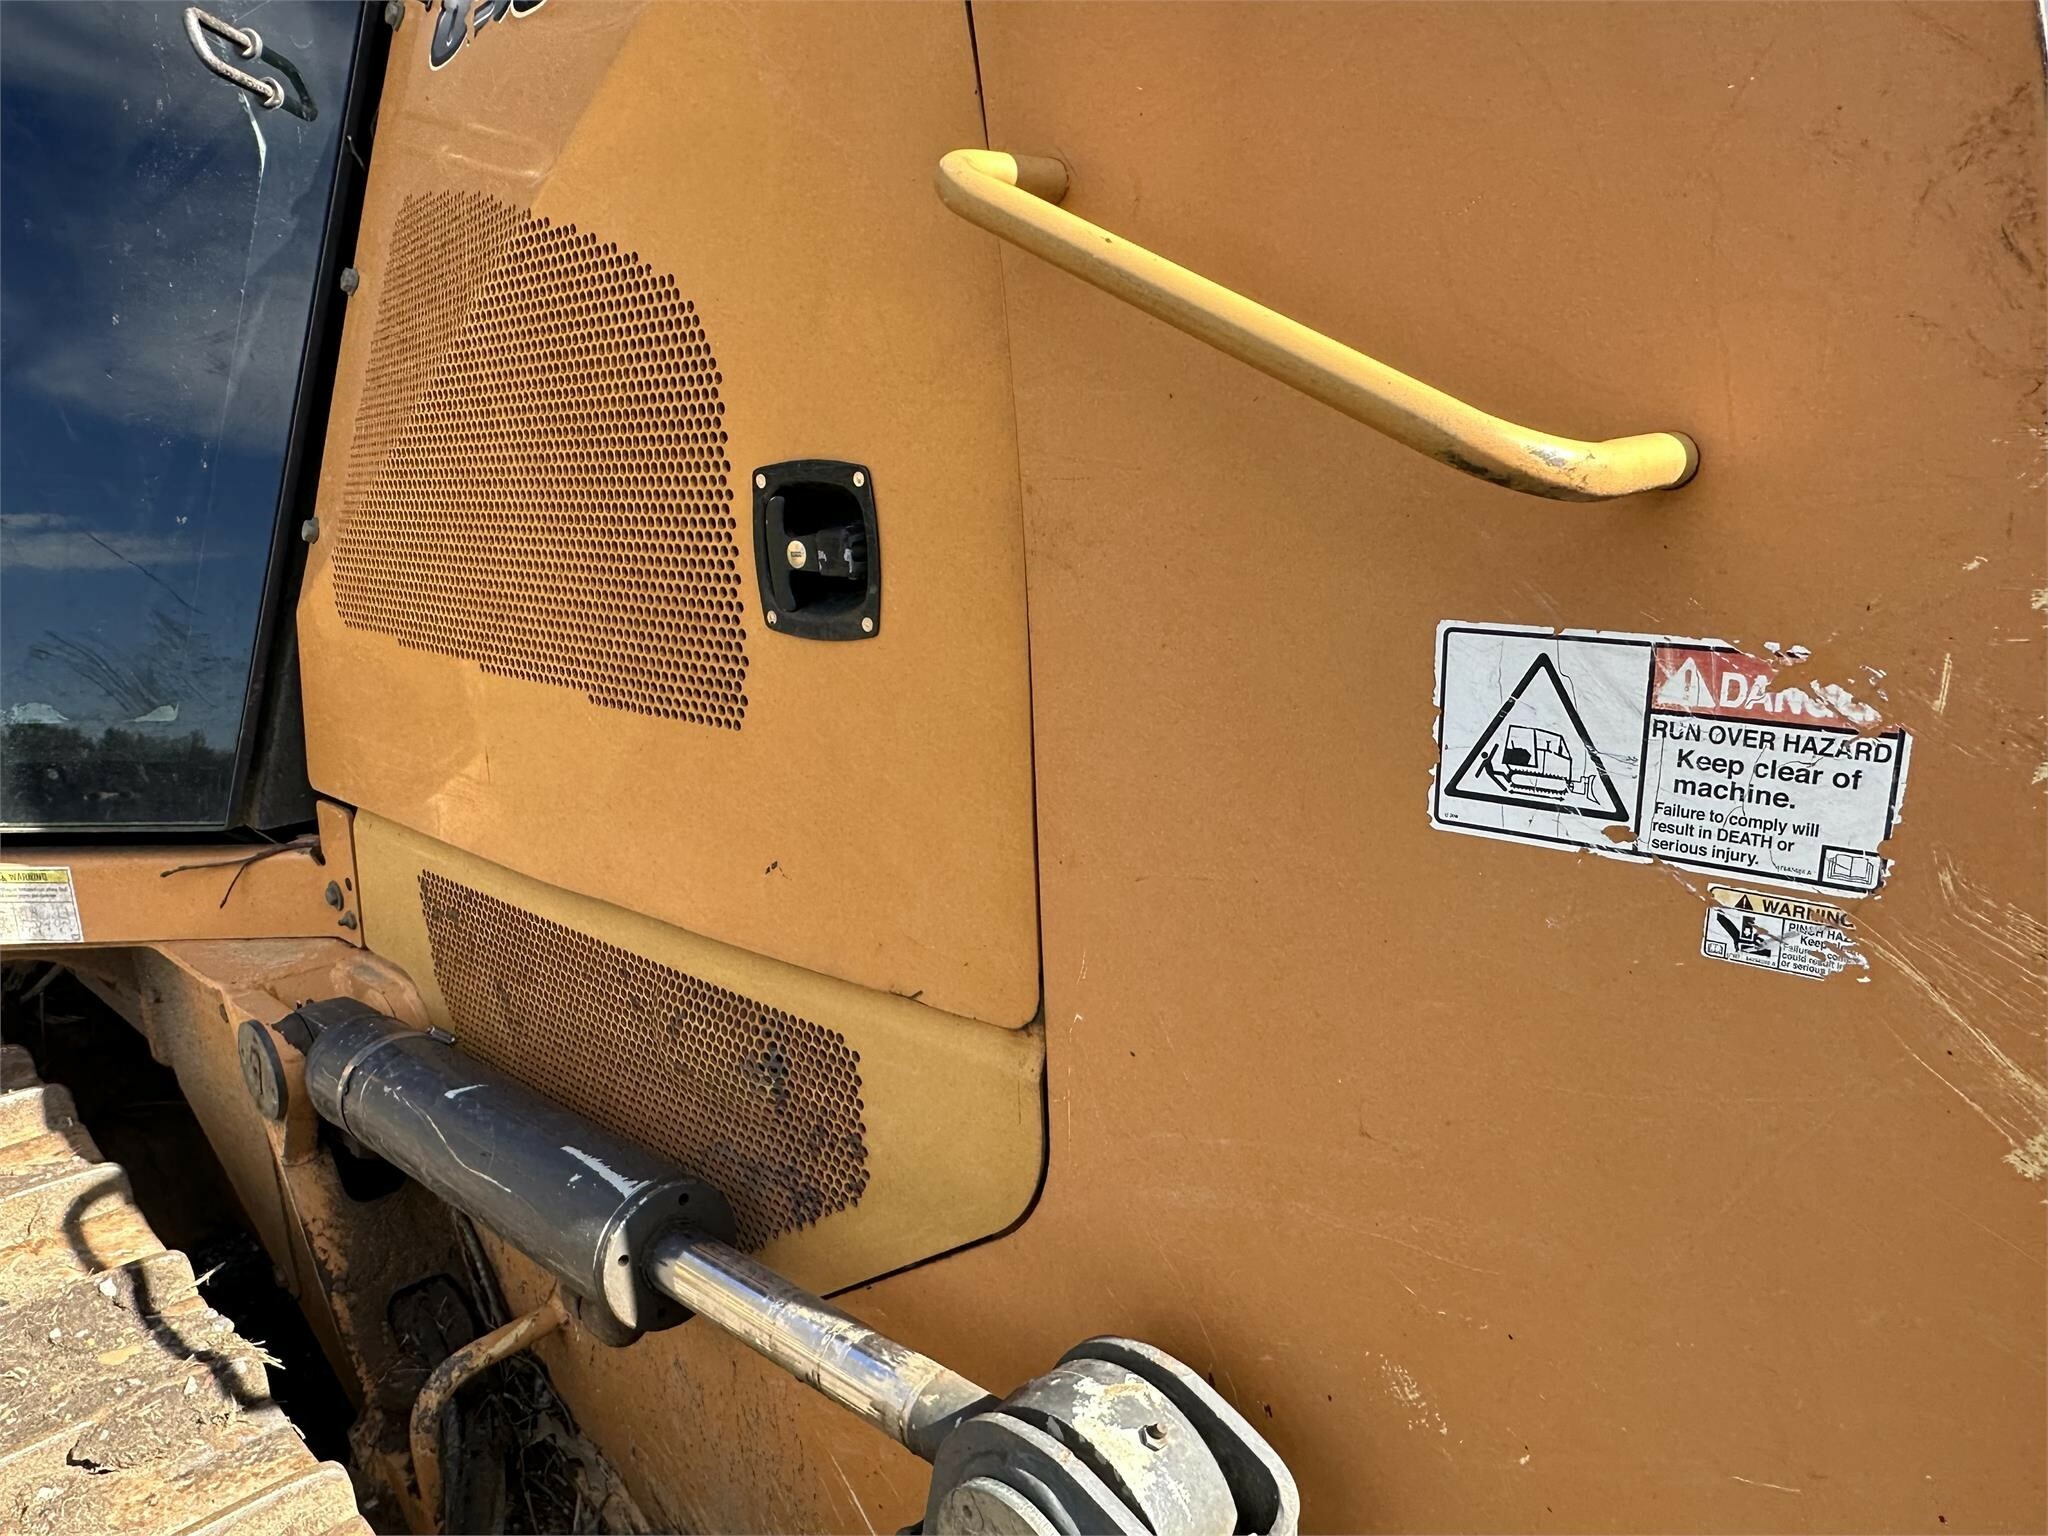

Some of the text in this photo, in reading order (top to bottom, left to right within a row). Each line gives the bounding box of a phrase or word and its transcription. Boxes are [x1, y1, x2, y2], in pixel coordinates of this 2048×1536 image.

[1652, 719, 1893, 763] RUN OVER HAZARD
[1676, 749, 1863, 790] Keep clear of
[1673, 777, 1796, 809] machine.
[1652, 820, 1795, 852] result in DEATH or
[1654, 802, 1820, 838] Failure to comply will
[1651, 837, 1759, 867] serious injury.
[1781, 952, 1807, 963] could
[1783, 944, 1811, 955] Failur
